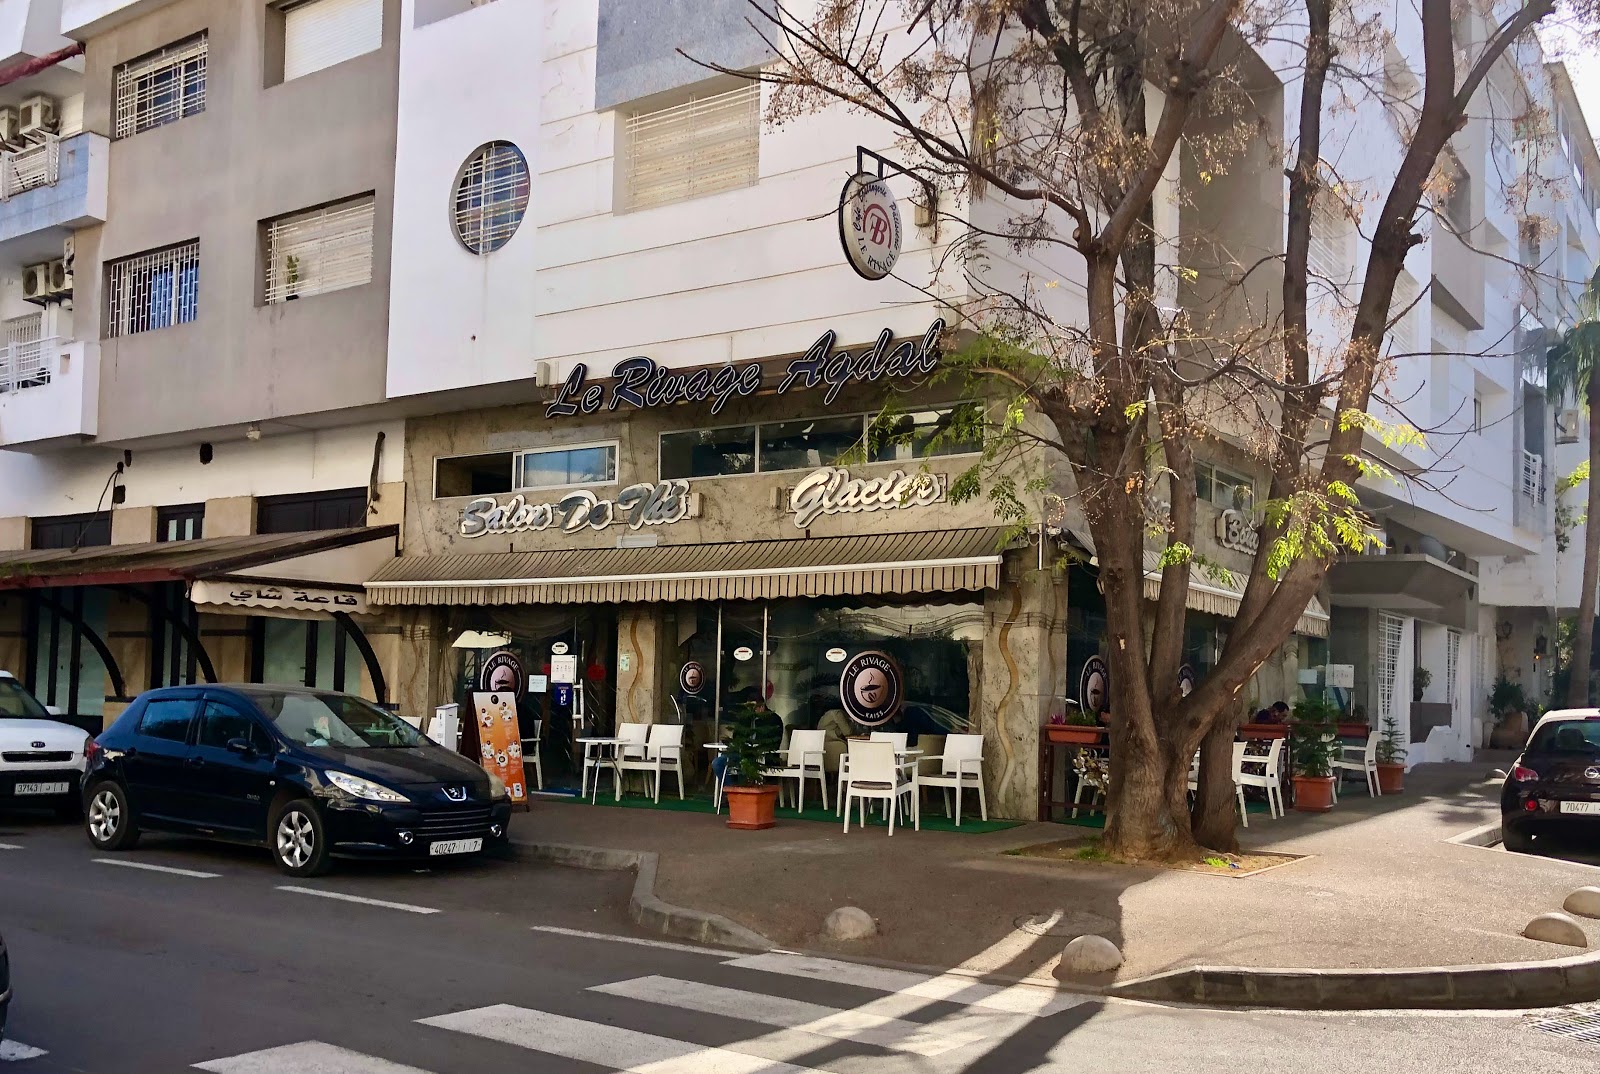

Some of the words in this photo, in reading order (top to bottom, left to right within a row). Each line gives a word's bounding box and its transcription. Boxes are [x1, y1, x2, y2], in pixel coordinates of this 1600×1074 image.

[545, 361, 605, 419] Le
[607, 355, 763, 416] Rivage
[776, 317, 947, 406] Agdal
[459, 494, 552, 538] Salon
[557, 489, 613, 534] De
[617, 480, 690, 530] Thé
[229, 587, 283, 602] شاي
[292, 591, 358, 606] قاعة
[488, 660, 498, 672] LE
[497, 655, 519, 672] RIVAGE
[849, 664, 860, 678] LE
[860, 656, 891, 672] RIVAGE
[1565, 802, 1590, 812] 70477
